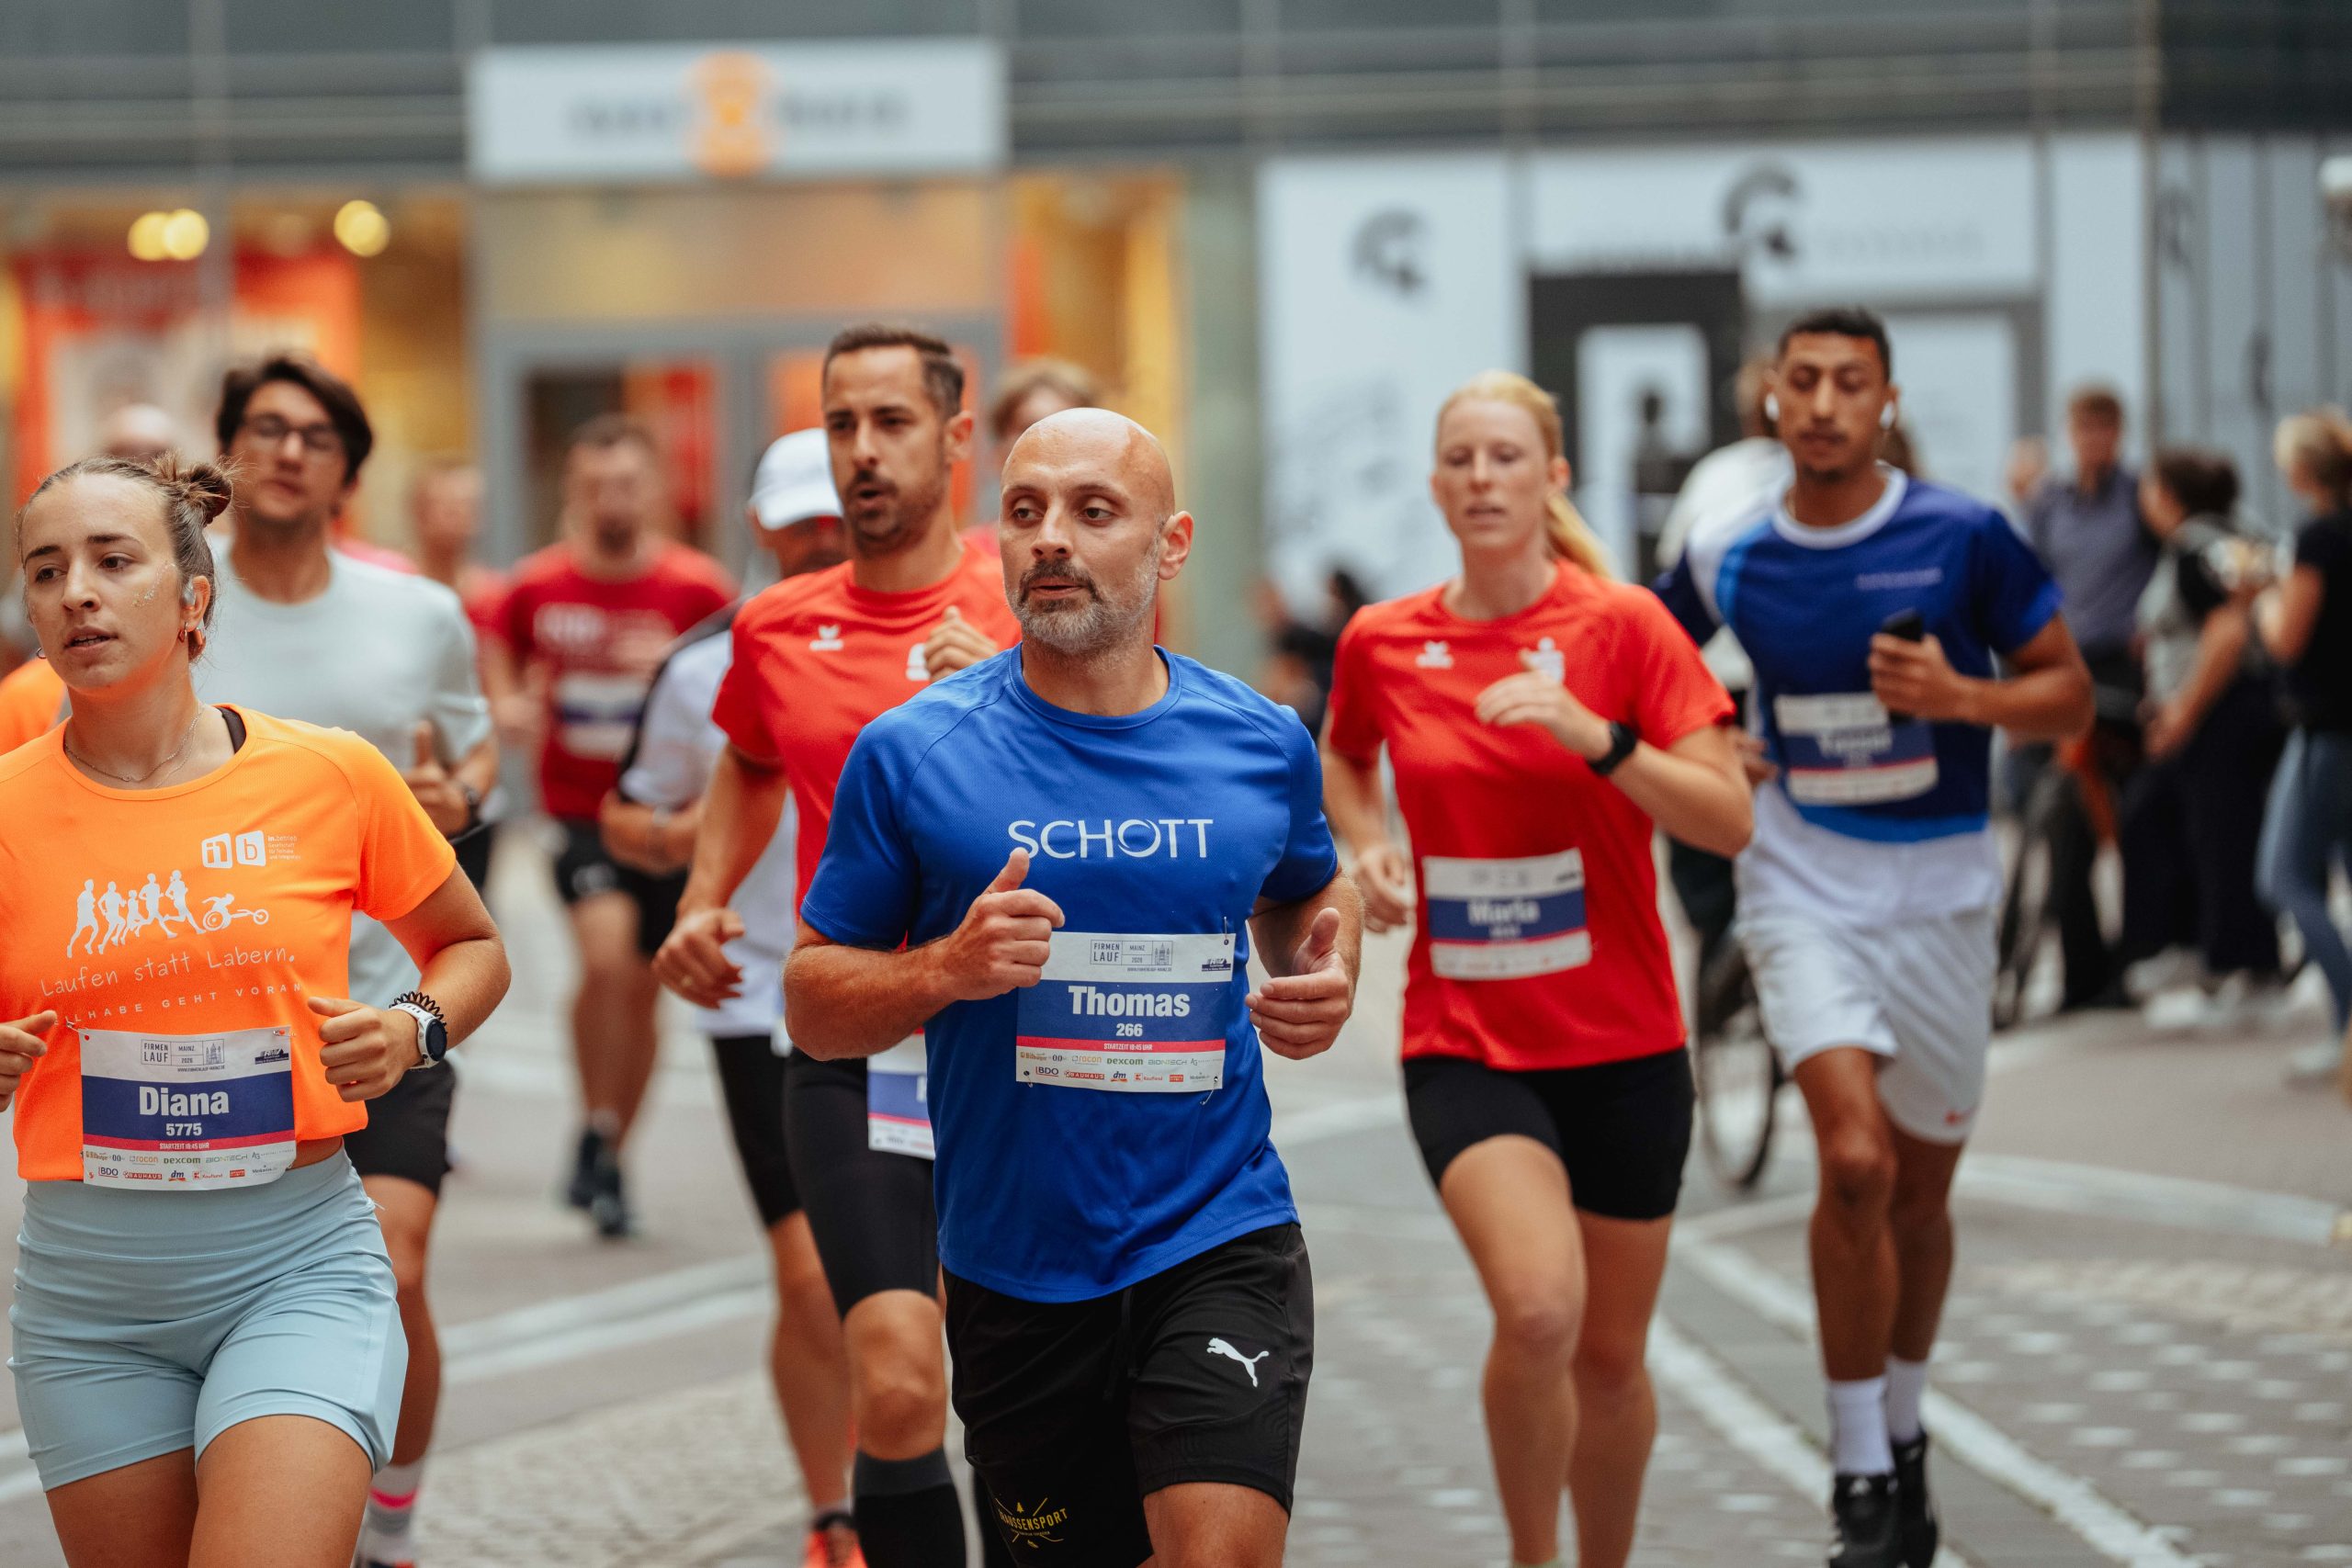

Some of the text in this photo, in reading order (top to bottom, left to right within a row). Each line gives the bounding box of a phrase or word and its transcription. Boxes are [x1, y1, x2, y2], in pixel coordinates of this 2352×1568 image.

[1007, 818, 1214, 859] SCHOTT
[1093, 942, 1120, 951] FIRMEN
[1093, 952, 1120, 963] LAUF
[41, 945, 296, 998] Laufen statt Labern.
[162, 991, 217, 1009] GEHT
[1068, 985, 1191, 1017] Thomas
[1115, 1022, 1143, 1037] 266
[143, 1043, 169, 1052] FIRMEN
[143, 1052, 169, 1063] LAUF
[1038, 1066, 1059, 1076] BDO
[1113, 1070, 1126, 1079] dm
[139, 1086, 230, 1116] Diana
[165, 1122, 202, 1136] 5775
[100, 1167, 119, 1176] BDO
